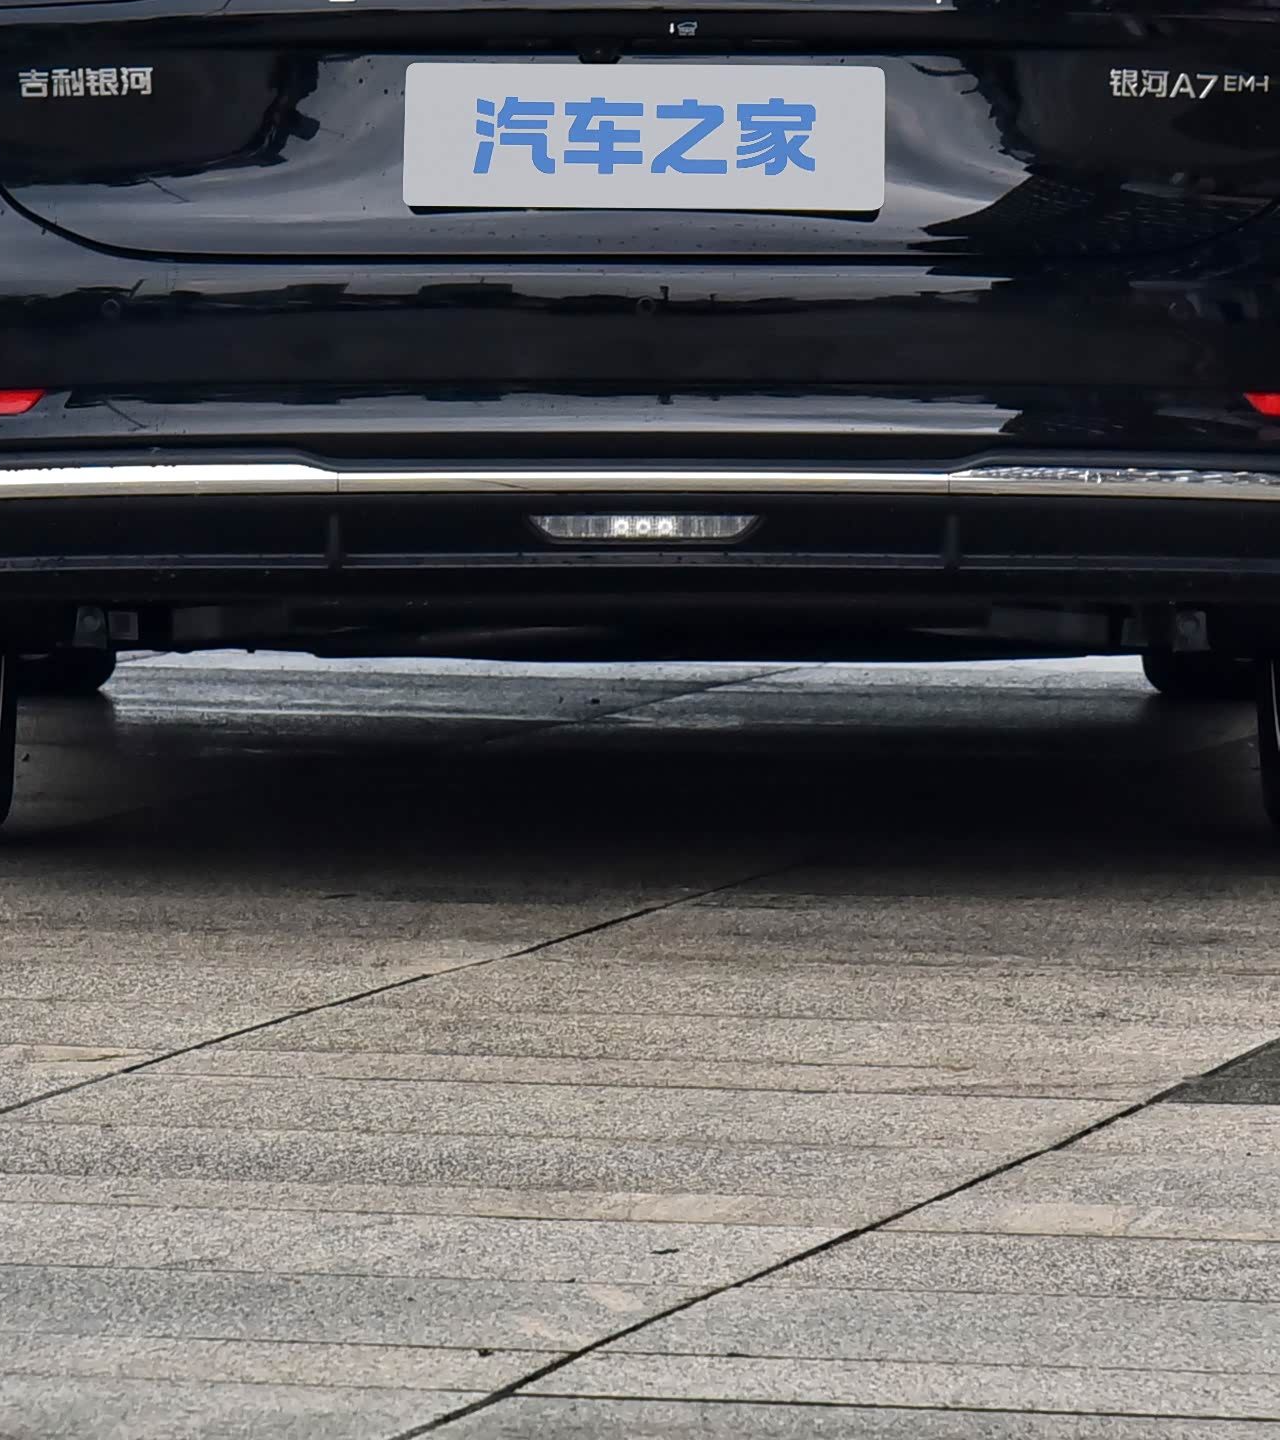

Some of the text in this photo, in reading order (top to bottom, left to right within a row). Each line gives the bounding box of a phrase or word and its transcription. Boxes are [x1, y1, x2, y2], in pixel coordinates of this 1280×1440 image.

[18, 66, 154, 98] 吉利银河
[472, 96, 817, 176] 汽车之家
